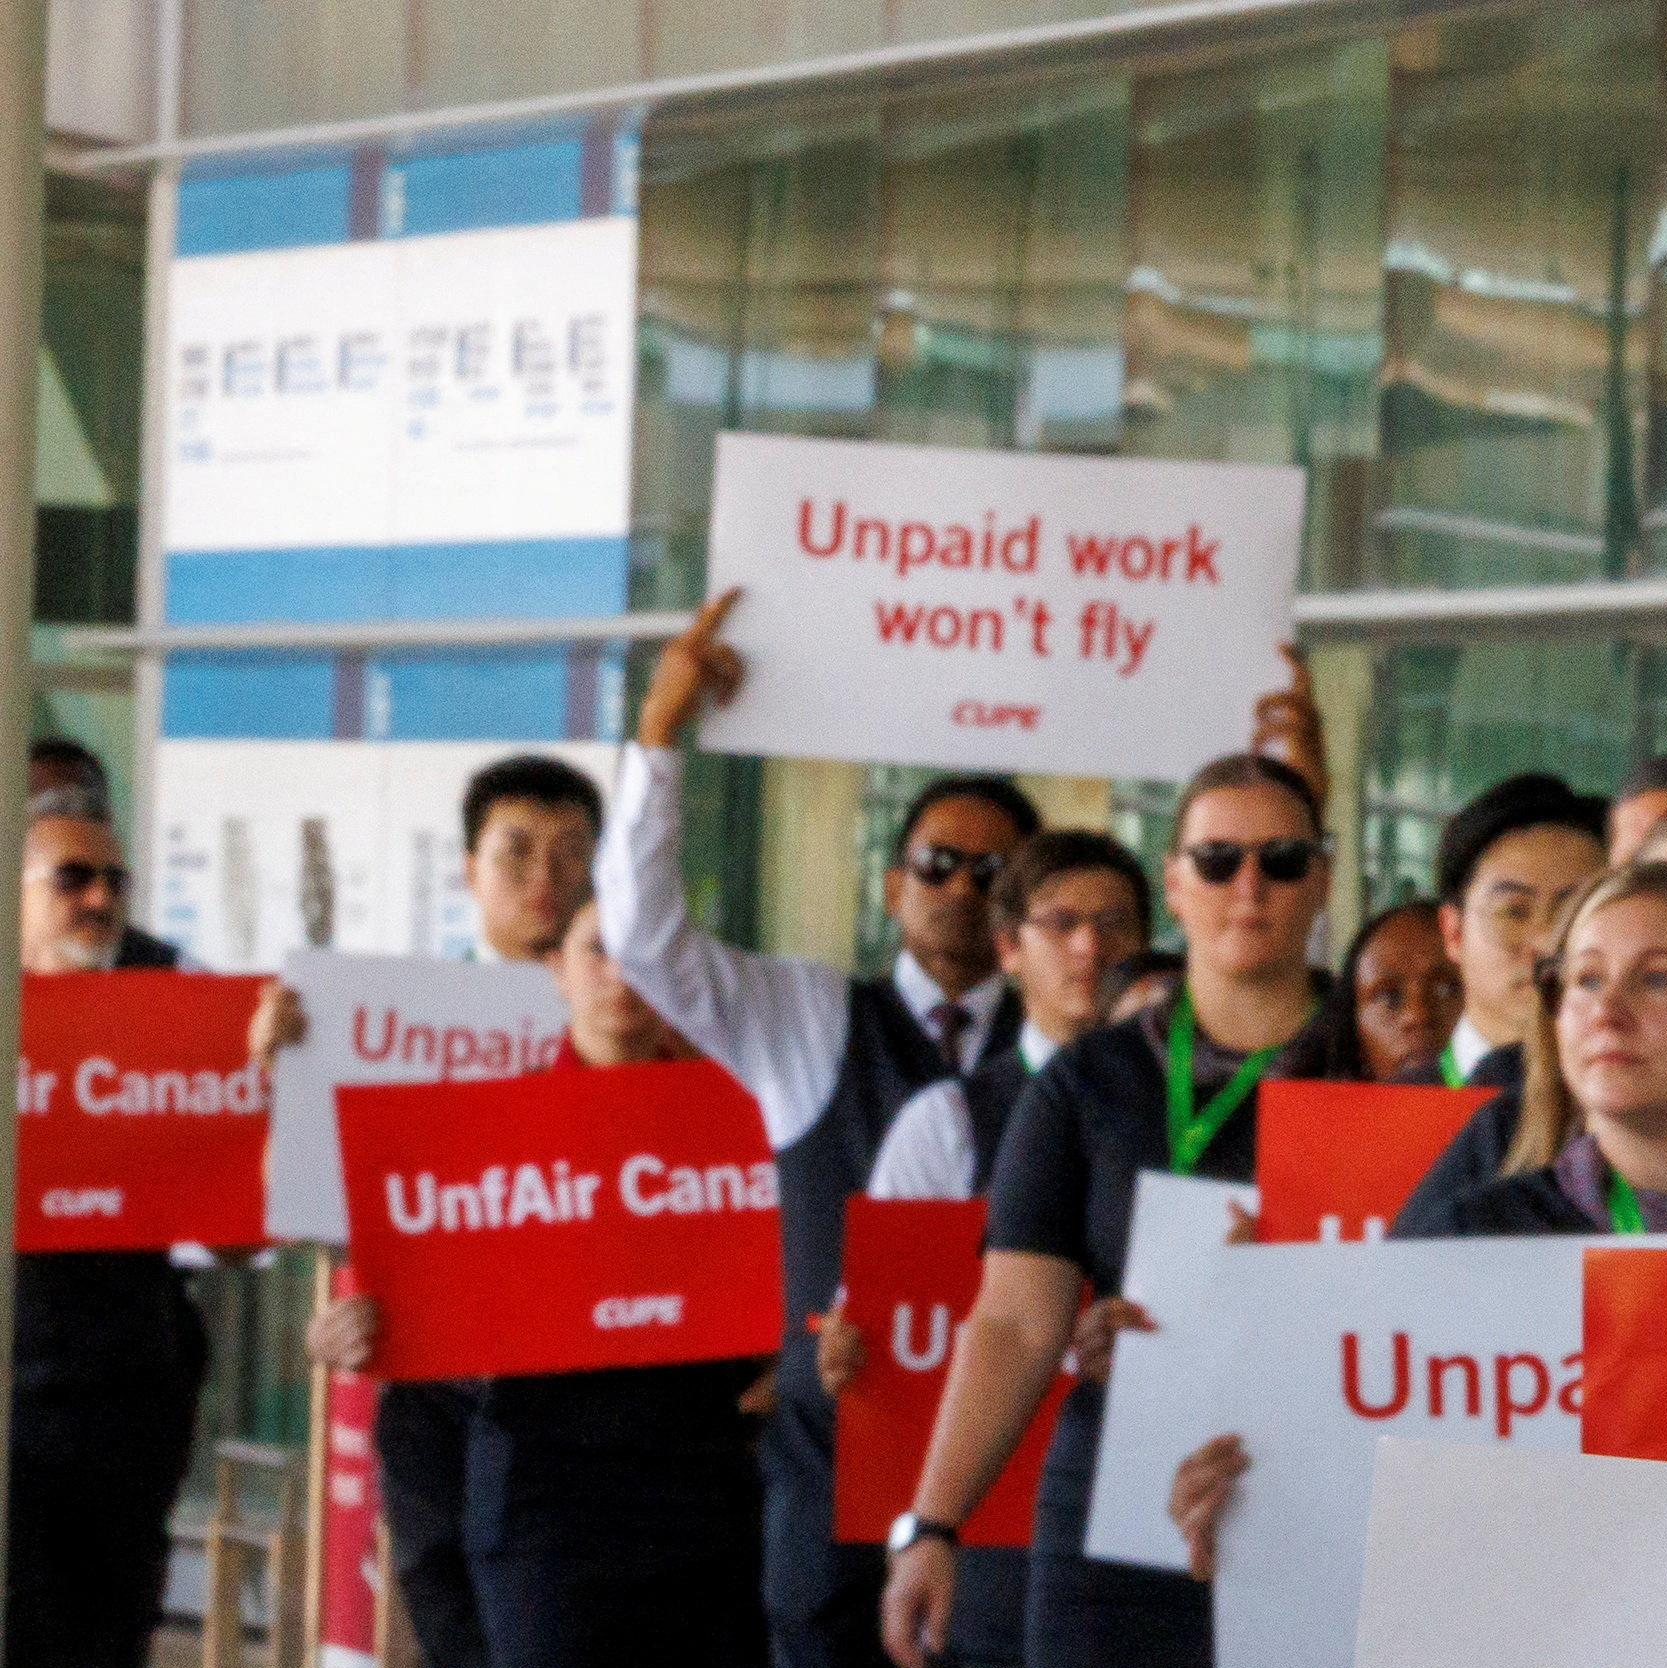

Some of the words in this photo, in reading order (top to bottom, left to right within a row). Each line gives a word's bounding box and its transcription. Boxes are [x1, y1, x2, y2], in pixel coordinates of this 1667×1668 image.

[797, 499, 1041, 577] Unpaid
[1067, 526, 1220, 582] work
[875, 598, 1051, 655] won't
[1078, 601, 1155, 675] fly
[954, 704, 1040, 729] CUPE
[74, 1055, 264, 1116] Canad
[386, 1159, 601, 1235] UnfAir
[618, 1153, 782, 1217] Cana
